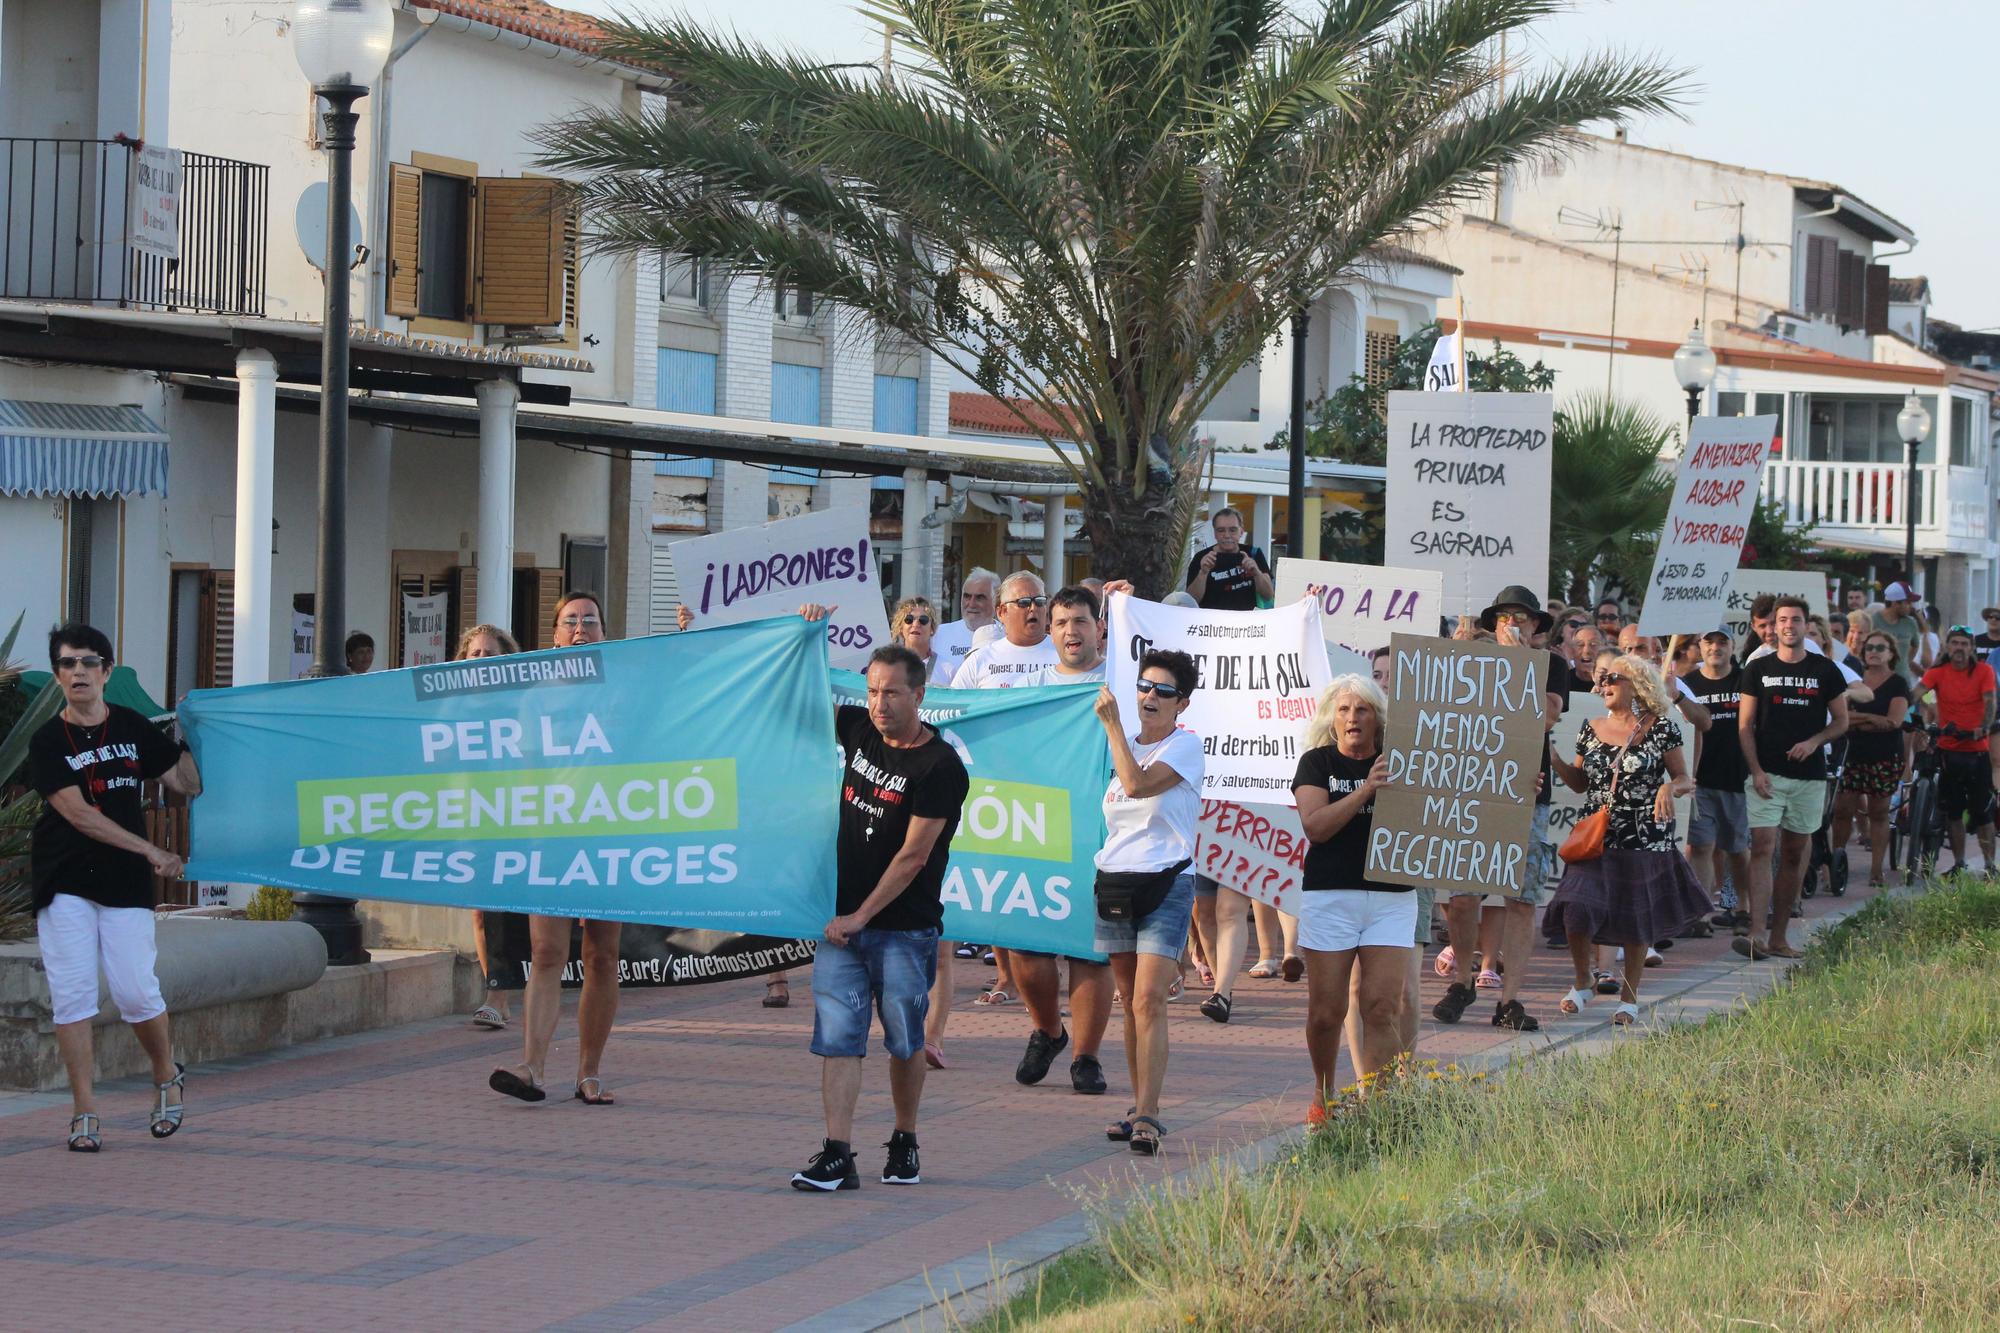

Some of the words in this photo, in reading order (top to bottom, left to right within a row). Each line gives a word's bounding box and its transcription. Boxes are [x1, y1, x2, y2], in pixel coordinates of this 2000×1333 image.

[1411, 422, 1430, 449] LA
[1439, 424, 1546, 451] PROPIEDAD
[1414, 458, 1505, 486] PRIVADA
[1689, 442, 1763, 474] AMENAZAR,
[1686, 479, 1745, 507] ACOSAR
[1432, 500, 1465, 521] ES
[1411, 531, 1514, 557] SAGRADA
[1672, 516, 1684, 545] Y
[1682, 522, 1745, 550] DERRIBAR
[701, 539, 868, 614] ¡LADRONES!
[1691, 563, 1706, 579] ES
[1354, 588, 1372, 618] A
[1383, 589, 1419, 622] LA
[1186, 623, 1267, 640] #salvemtorrelasal
[422, 655, 598, 693] SOMMEDITERRANIA
[988, 663, 1014, 675] TORRE
[1016, 663, 1027, 674] DE
[1028, 663, 1039, 673] LA
[1215, 655, 1242, 691] DE
[1248, 655, 1271, 691] LA
[1276, 652, 1311, 698] SAL
[1258, 700, 1272, 720] es
[420, 718, 523, 763] PER
[540, 712, 614, 758] LA
[1203, 735, 1218, 757] al
[1221, 734, 1279, 757] derribo
[1415, 708, 1505, 755] MENOS
[322, 765, 715, 836] REGENERACIÓ
[1422, 792, 1480, 835] MÁS
[290, 844, 363, 877] DE
[380, 849, 477, 884] LES
[492, 843, 739, 887] PLATGES
[1369, 827, 1523, 891] REGENERAR
[939, 866, 1072, 921] AYAS
[747, 909, 759, 917] de
